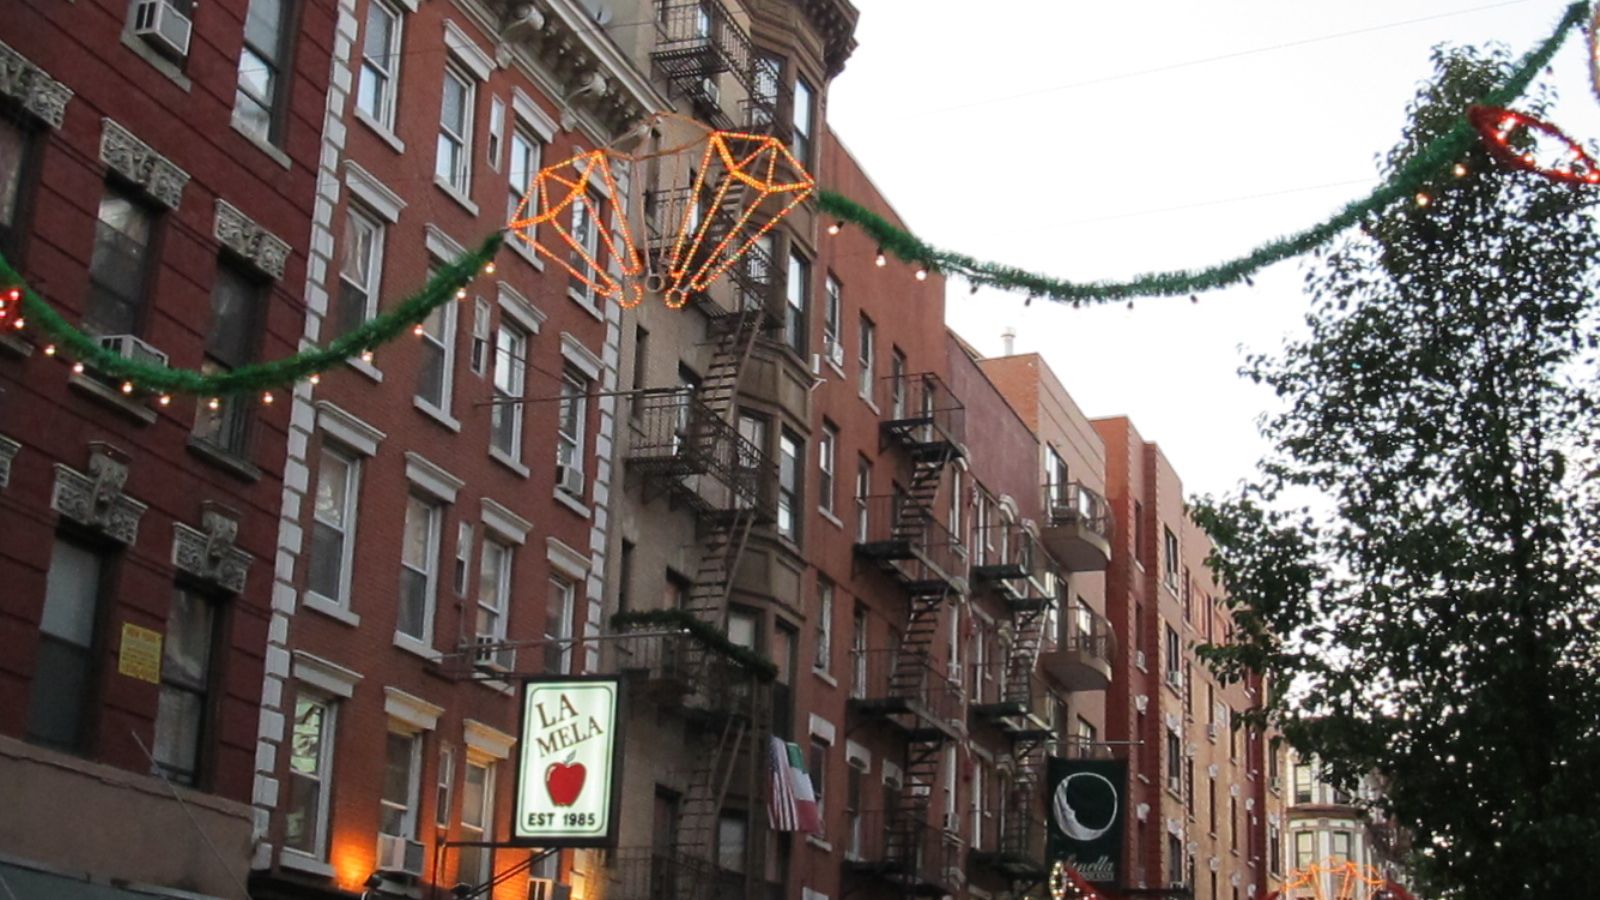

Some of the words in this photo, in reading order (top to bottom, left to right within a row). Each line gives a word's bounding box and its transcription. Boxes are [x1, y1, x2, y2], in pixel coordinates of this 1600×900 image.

[535, 693, 578, 729] LA
[535, 716, 604, 757] MELA
[528, 813, 555, 826] EST
[563, 812, 596, 826] 1985
